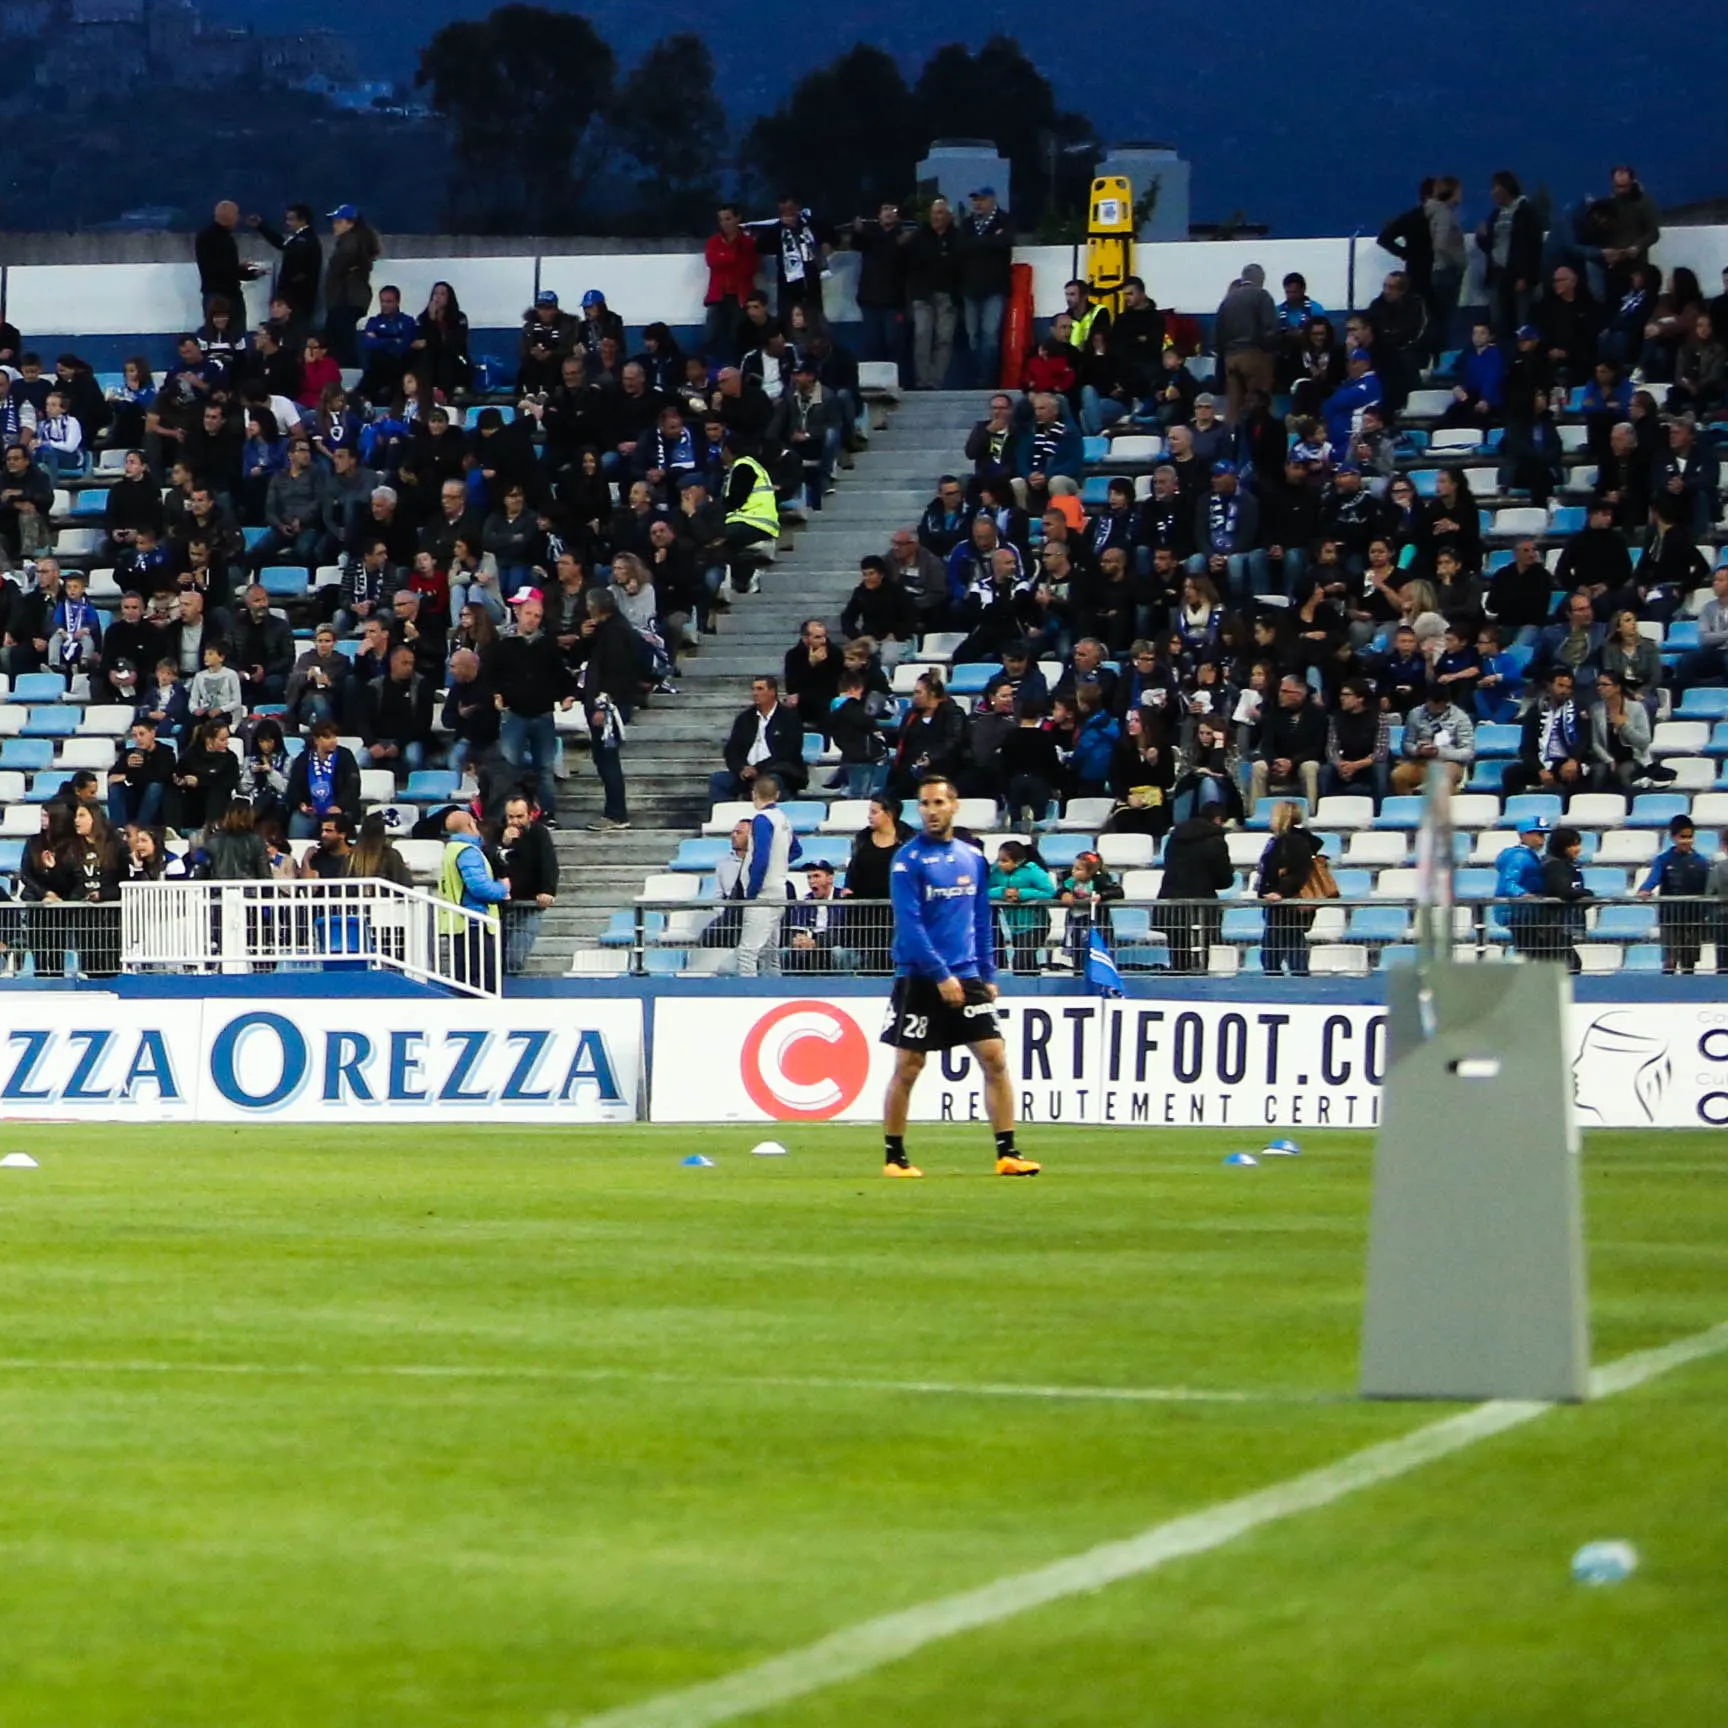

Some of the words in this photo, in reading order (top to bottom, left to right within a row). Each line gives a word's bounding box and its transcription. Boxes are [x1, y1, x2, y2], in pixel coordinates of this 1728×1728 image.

[903, 1014, 929, 1039] 28
[941, 1008, 1389, 1085] CRTIFOOT.CO
[210, 1011, 626, 1111] OREZZA
[941, 1091, 1232, 1123] RERUTEMENT
